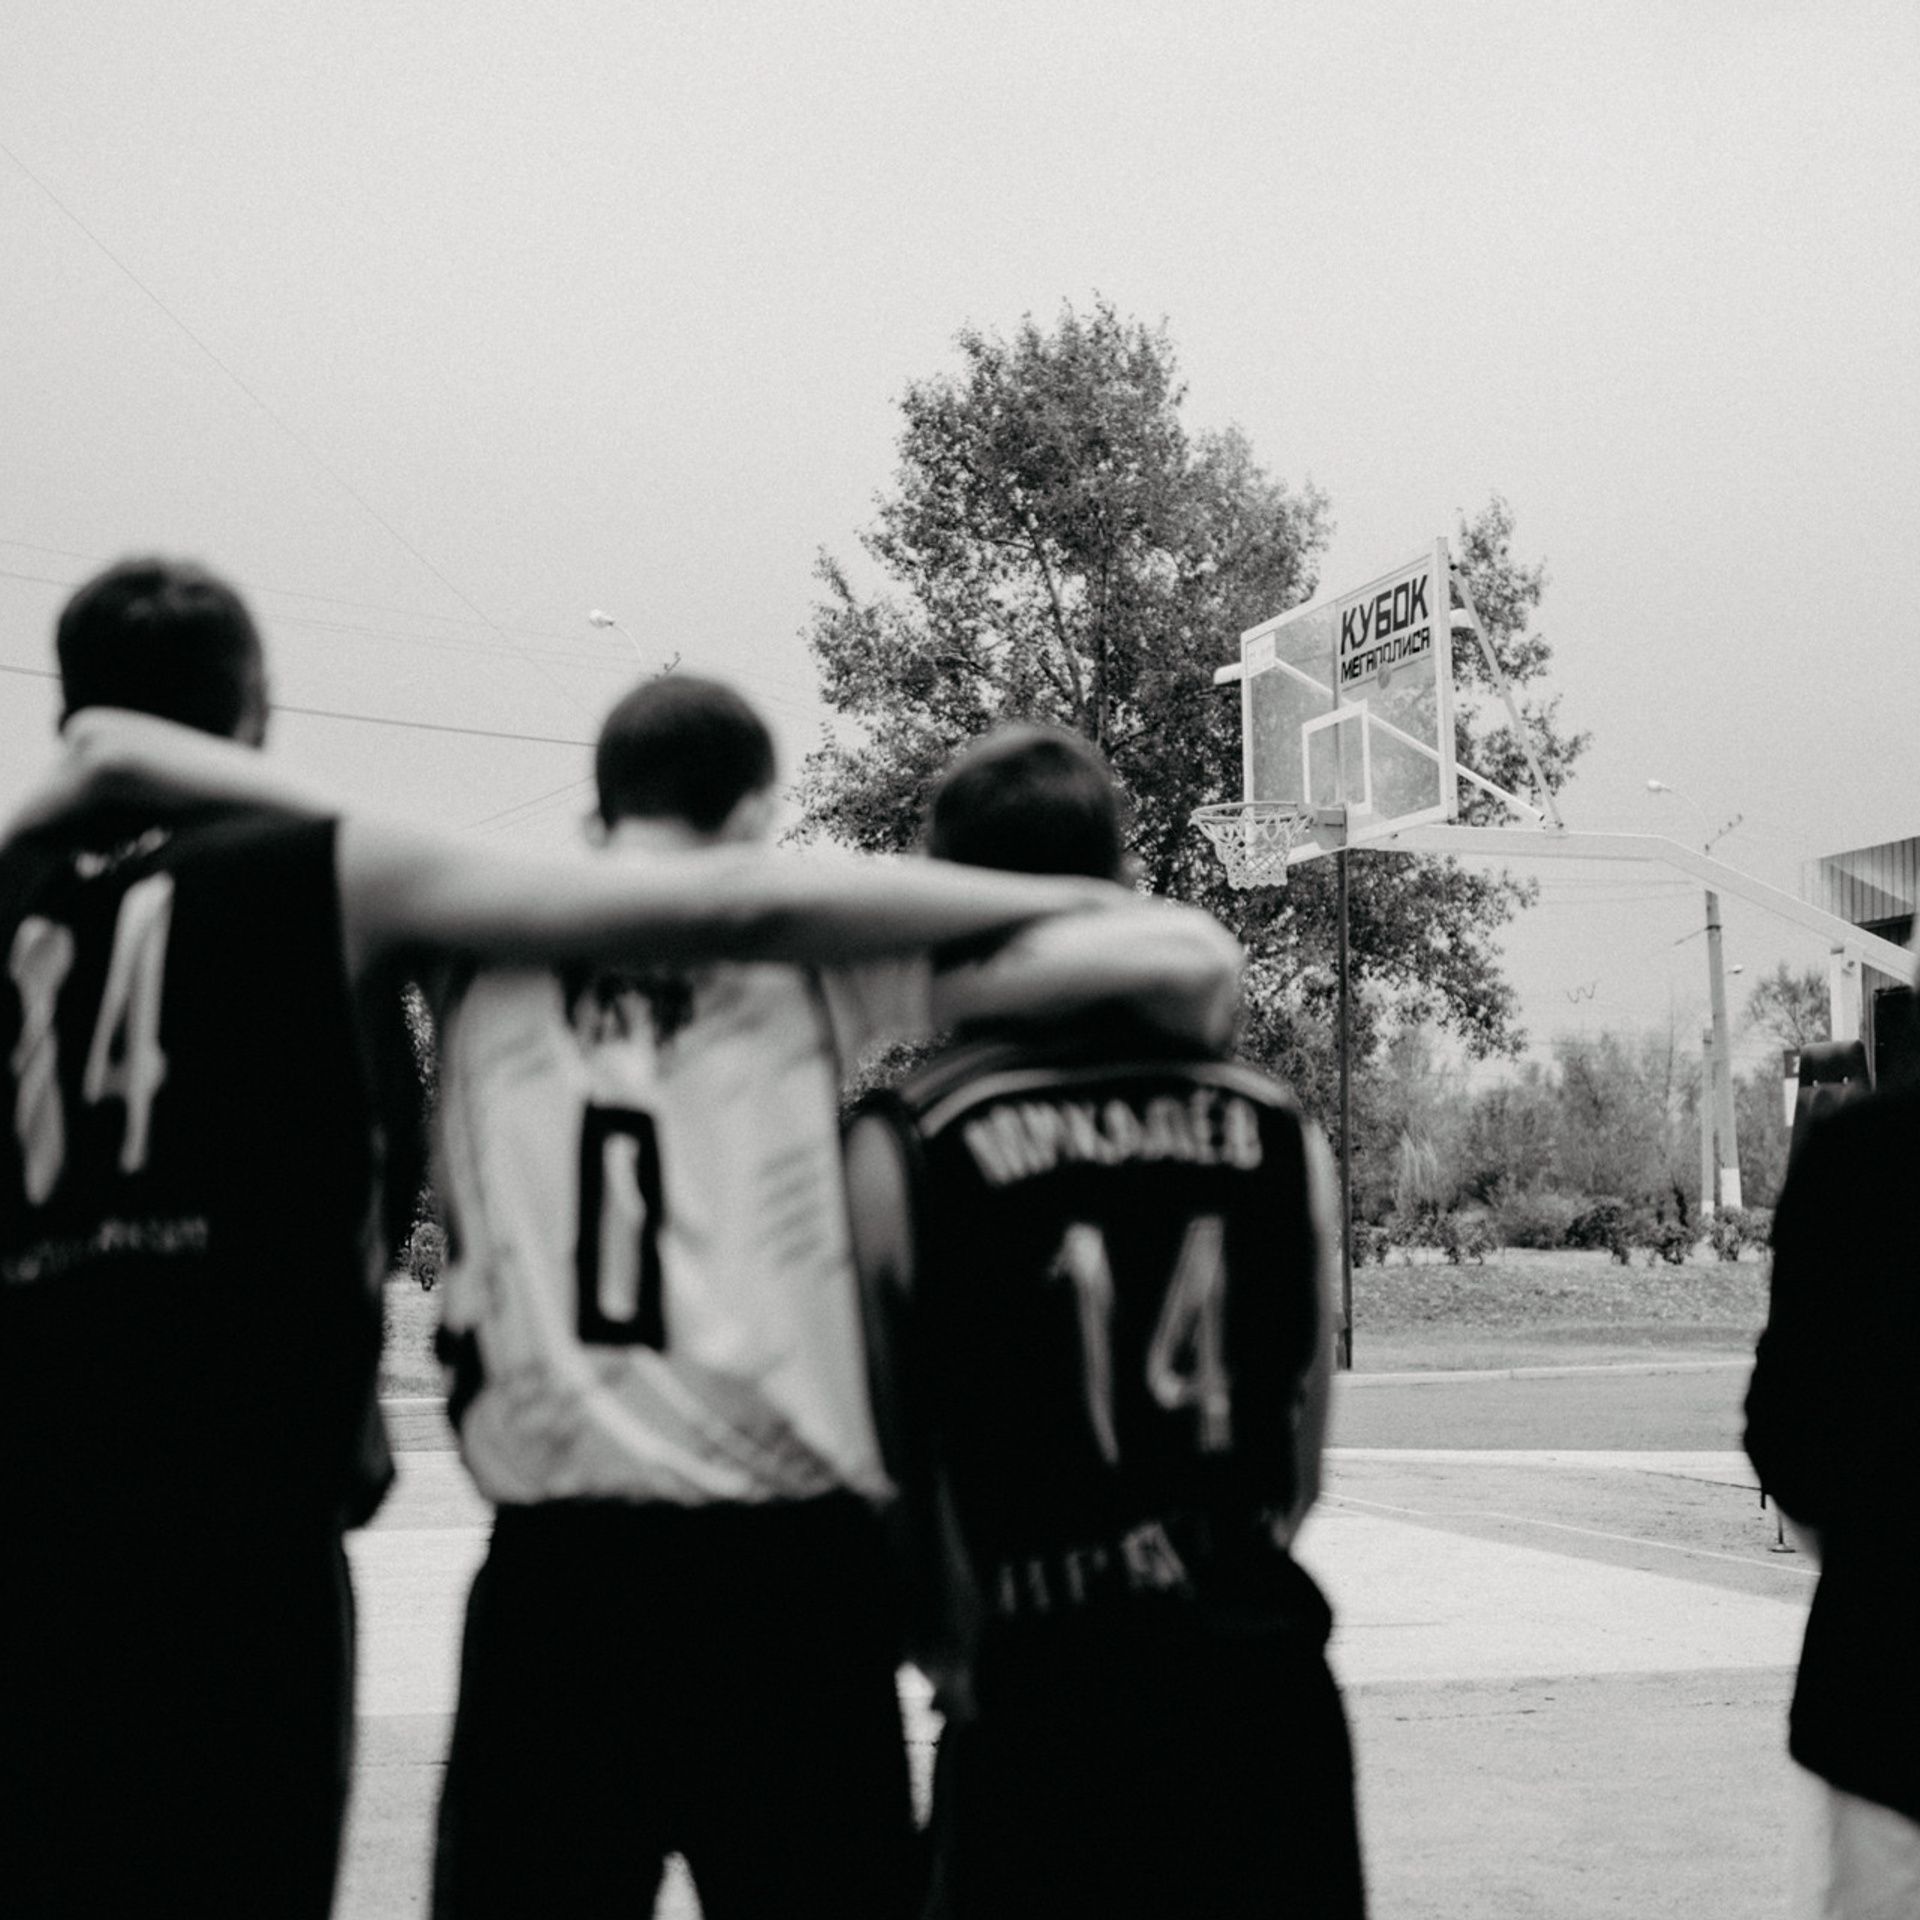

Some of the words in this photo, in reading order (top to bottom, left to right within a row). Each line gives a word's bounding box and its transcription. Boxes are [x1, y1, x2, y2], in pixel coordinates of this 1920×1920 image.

[1340, 574, 1428, 655] КУБОК
[1340, 626, 1431, 683] МЕГАПОЛИСА
[577, 1103, 666, 1350] 0
[1048, 1216, 1232, 1464] 14
